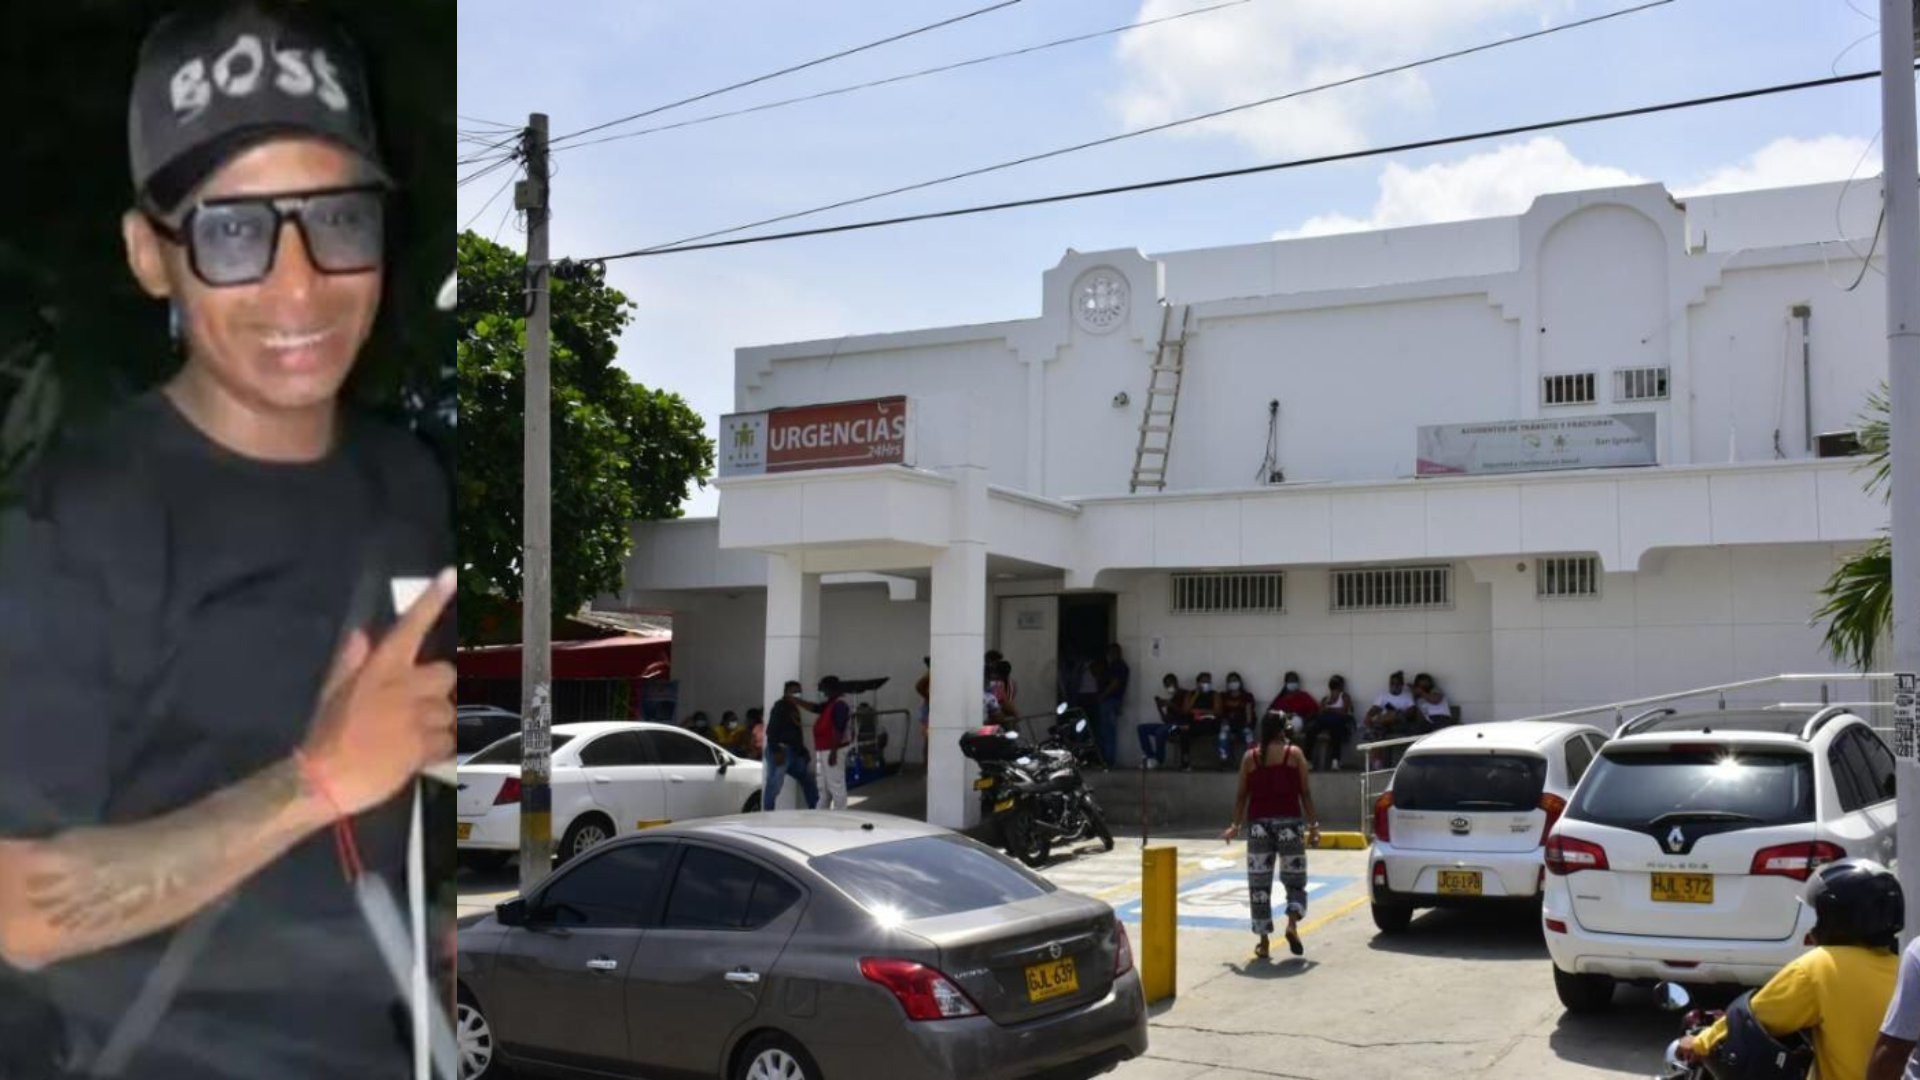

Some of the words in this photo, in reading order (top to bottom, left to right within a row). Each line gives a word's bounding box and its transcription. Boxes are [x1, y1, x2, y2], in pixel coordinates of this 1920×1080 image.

[170, 33, 349, 124] BOSS
[769, 415, 905, 452] URGENCIAS
[1652, 876, 1679, 893] HJL
[1684, 877, 1711, 895] 372
